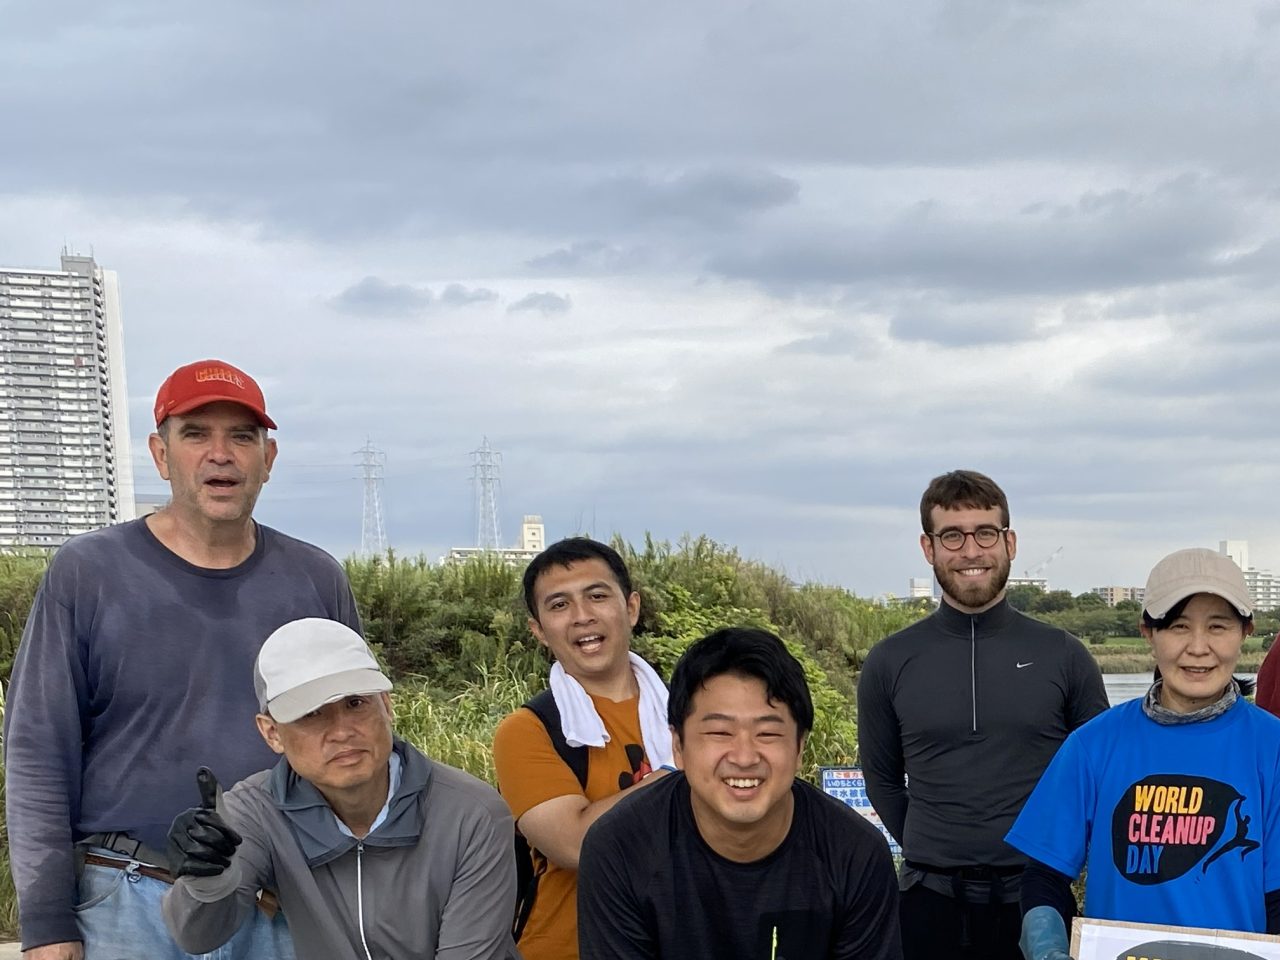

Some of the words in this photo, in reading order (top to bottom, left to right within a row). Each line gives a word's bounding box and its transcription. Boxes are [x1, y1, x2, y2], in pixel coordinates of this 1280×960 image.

[1134, 785, 1203, 814] WORLD
[1128, 813, 1216, 845] CLEANUP
[1126, 845, 1164, 874] DAY
